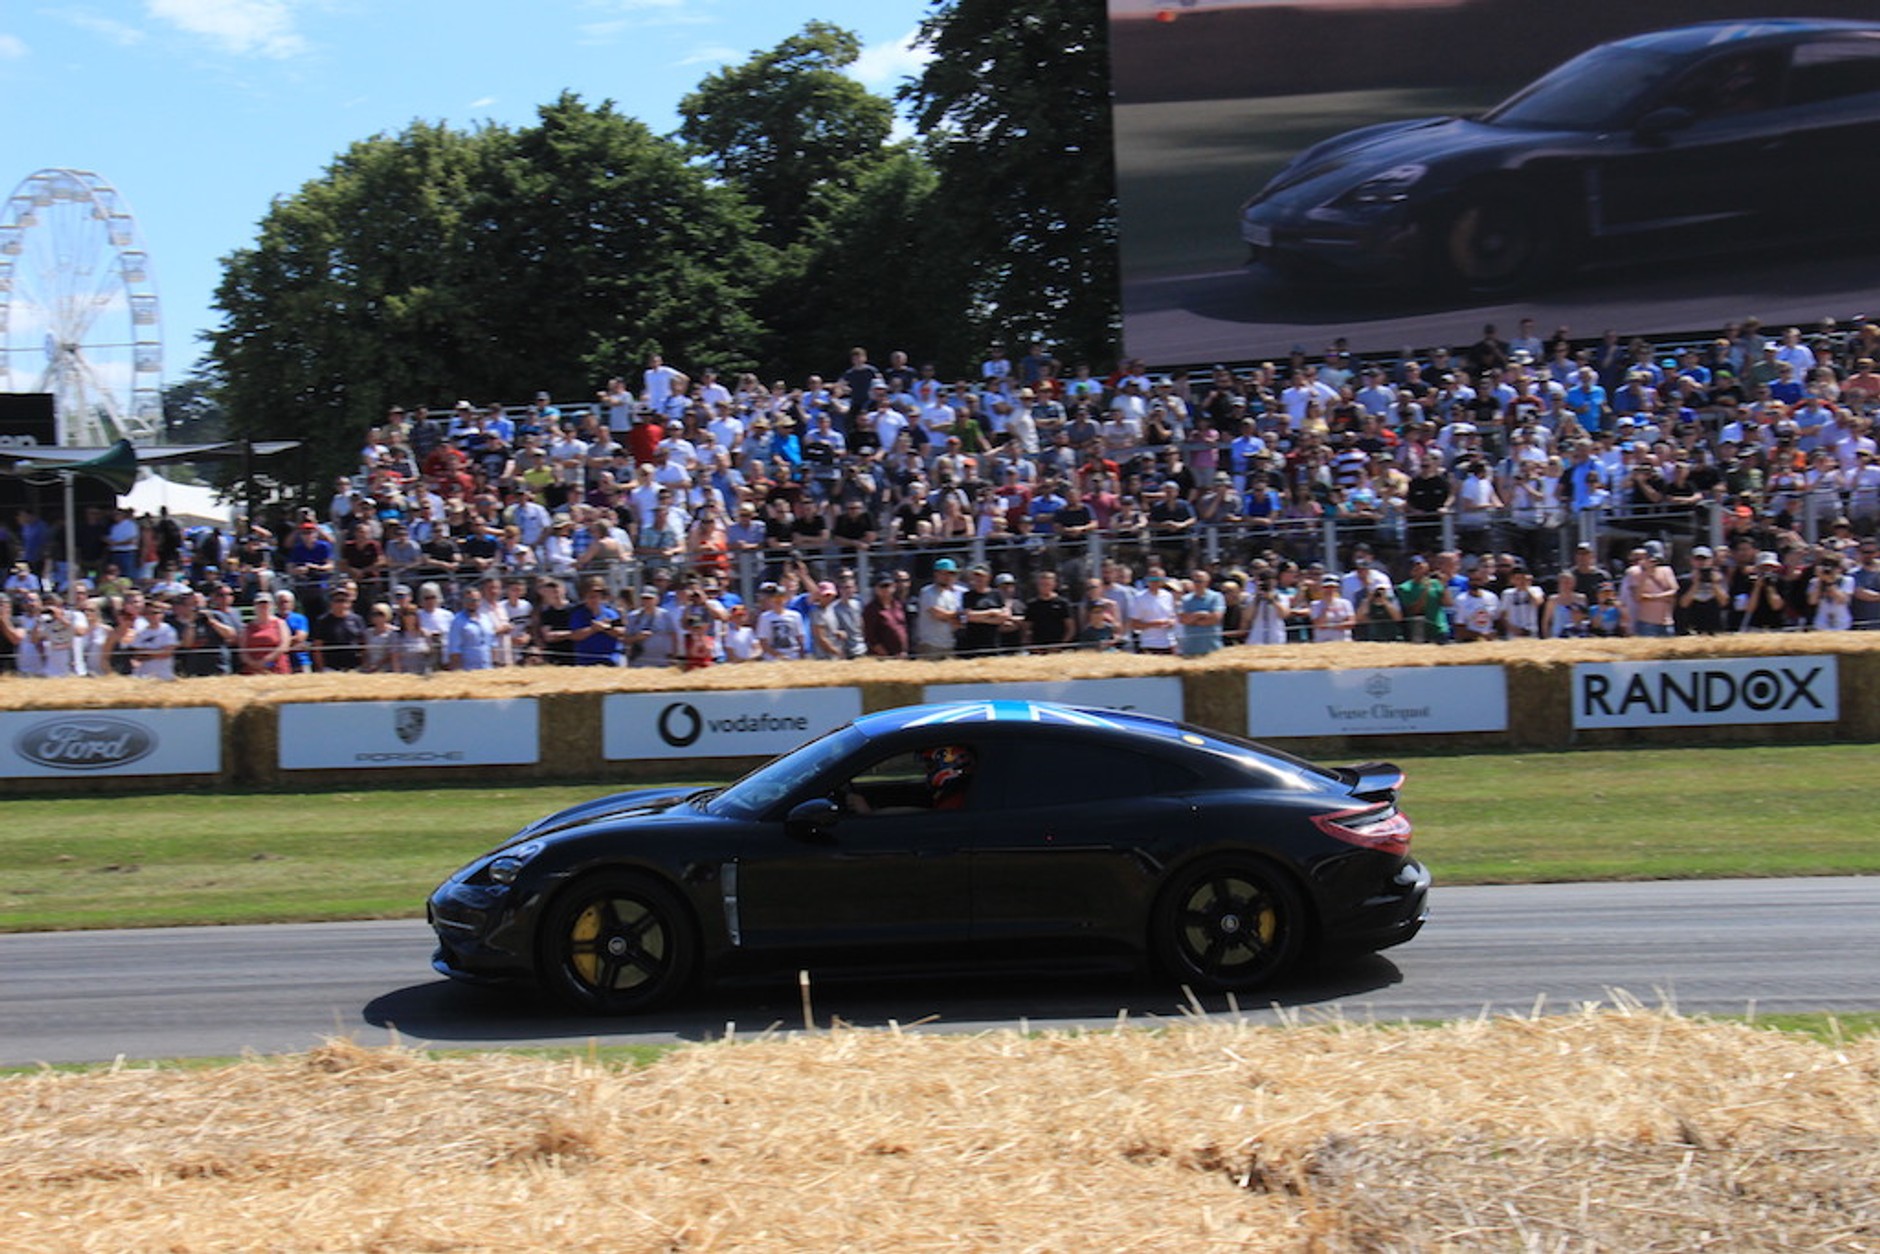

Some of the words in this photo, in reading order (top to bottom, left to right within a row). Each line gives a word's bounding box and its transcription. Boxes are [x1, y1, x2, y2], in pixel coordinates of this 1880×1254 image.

[1583, 667, 1825, 715] RANDOX
[39, 723, 132, 759] Ford
[707, 713, 808, 733] vodafone
